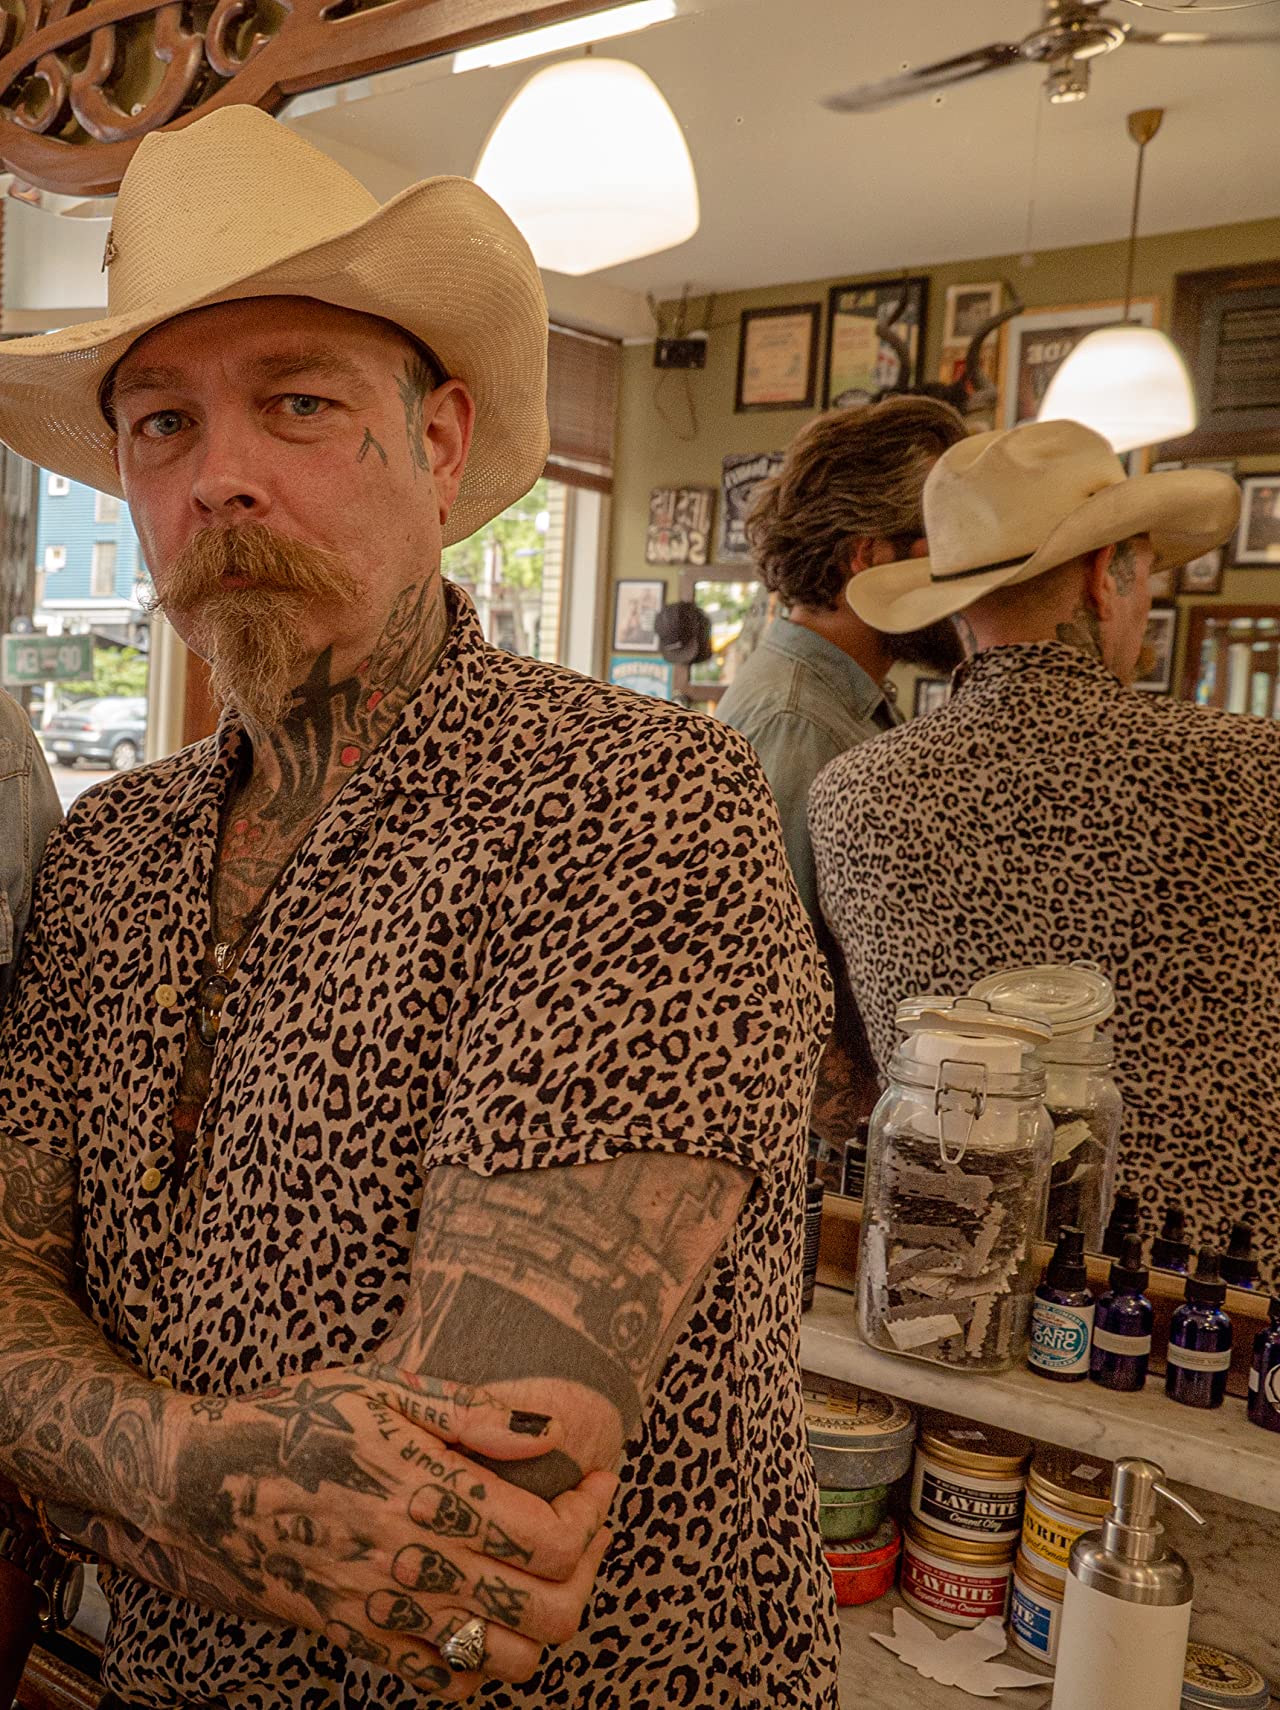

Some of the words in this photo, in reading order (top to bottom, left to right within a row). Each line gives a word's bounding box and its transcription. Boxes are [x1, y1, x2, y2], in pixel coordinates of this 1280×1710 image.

[1034, 1332, 1075, 1350] ONIC
[934, 1488, 1019, 1516] LAYRITE
[949, 1512, 982, 1527] Cement
[982, 1519, 1003, 1532] Clay
[911, 1566, 994, 1601] LAYRITE
[957, 1602, 987, 1614] Cream
